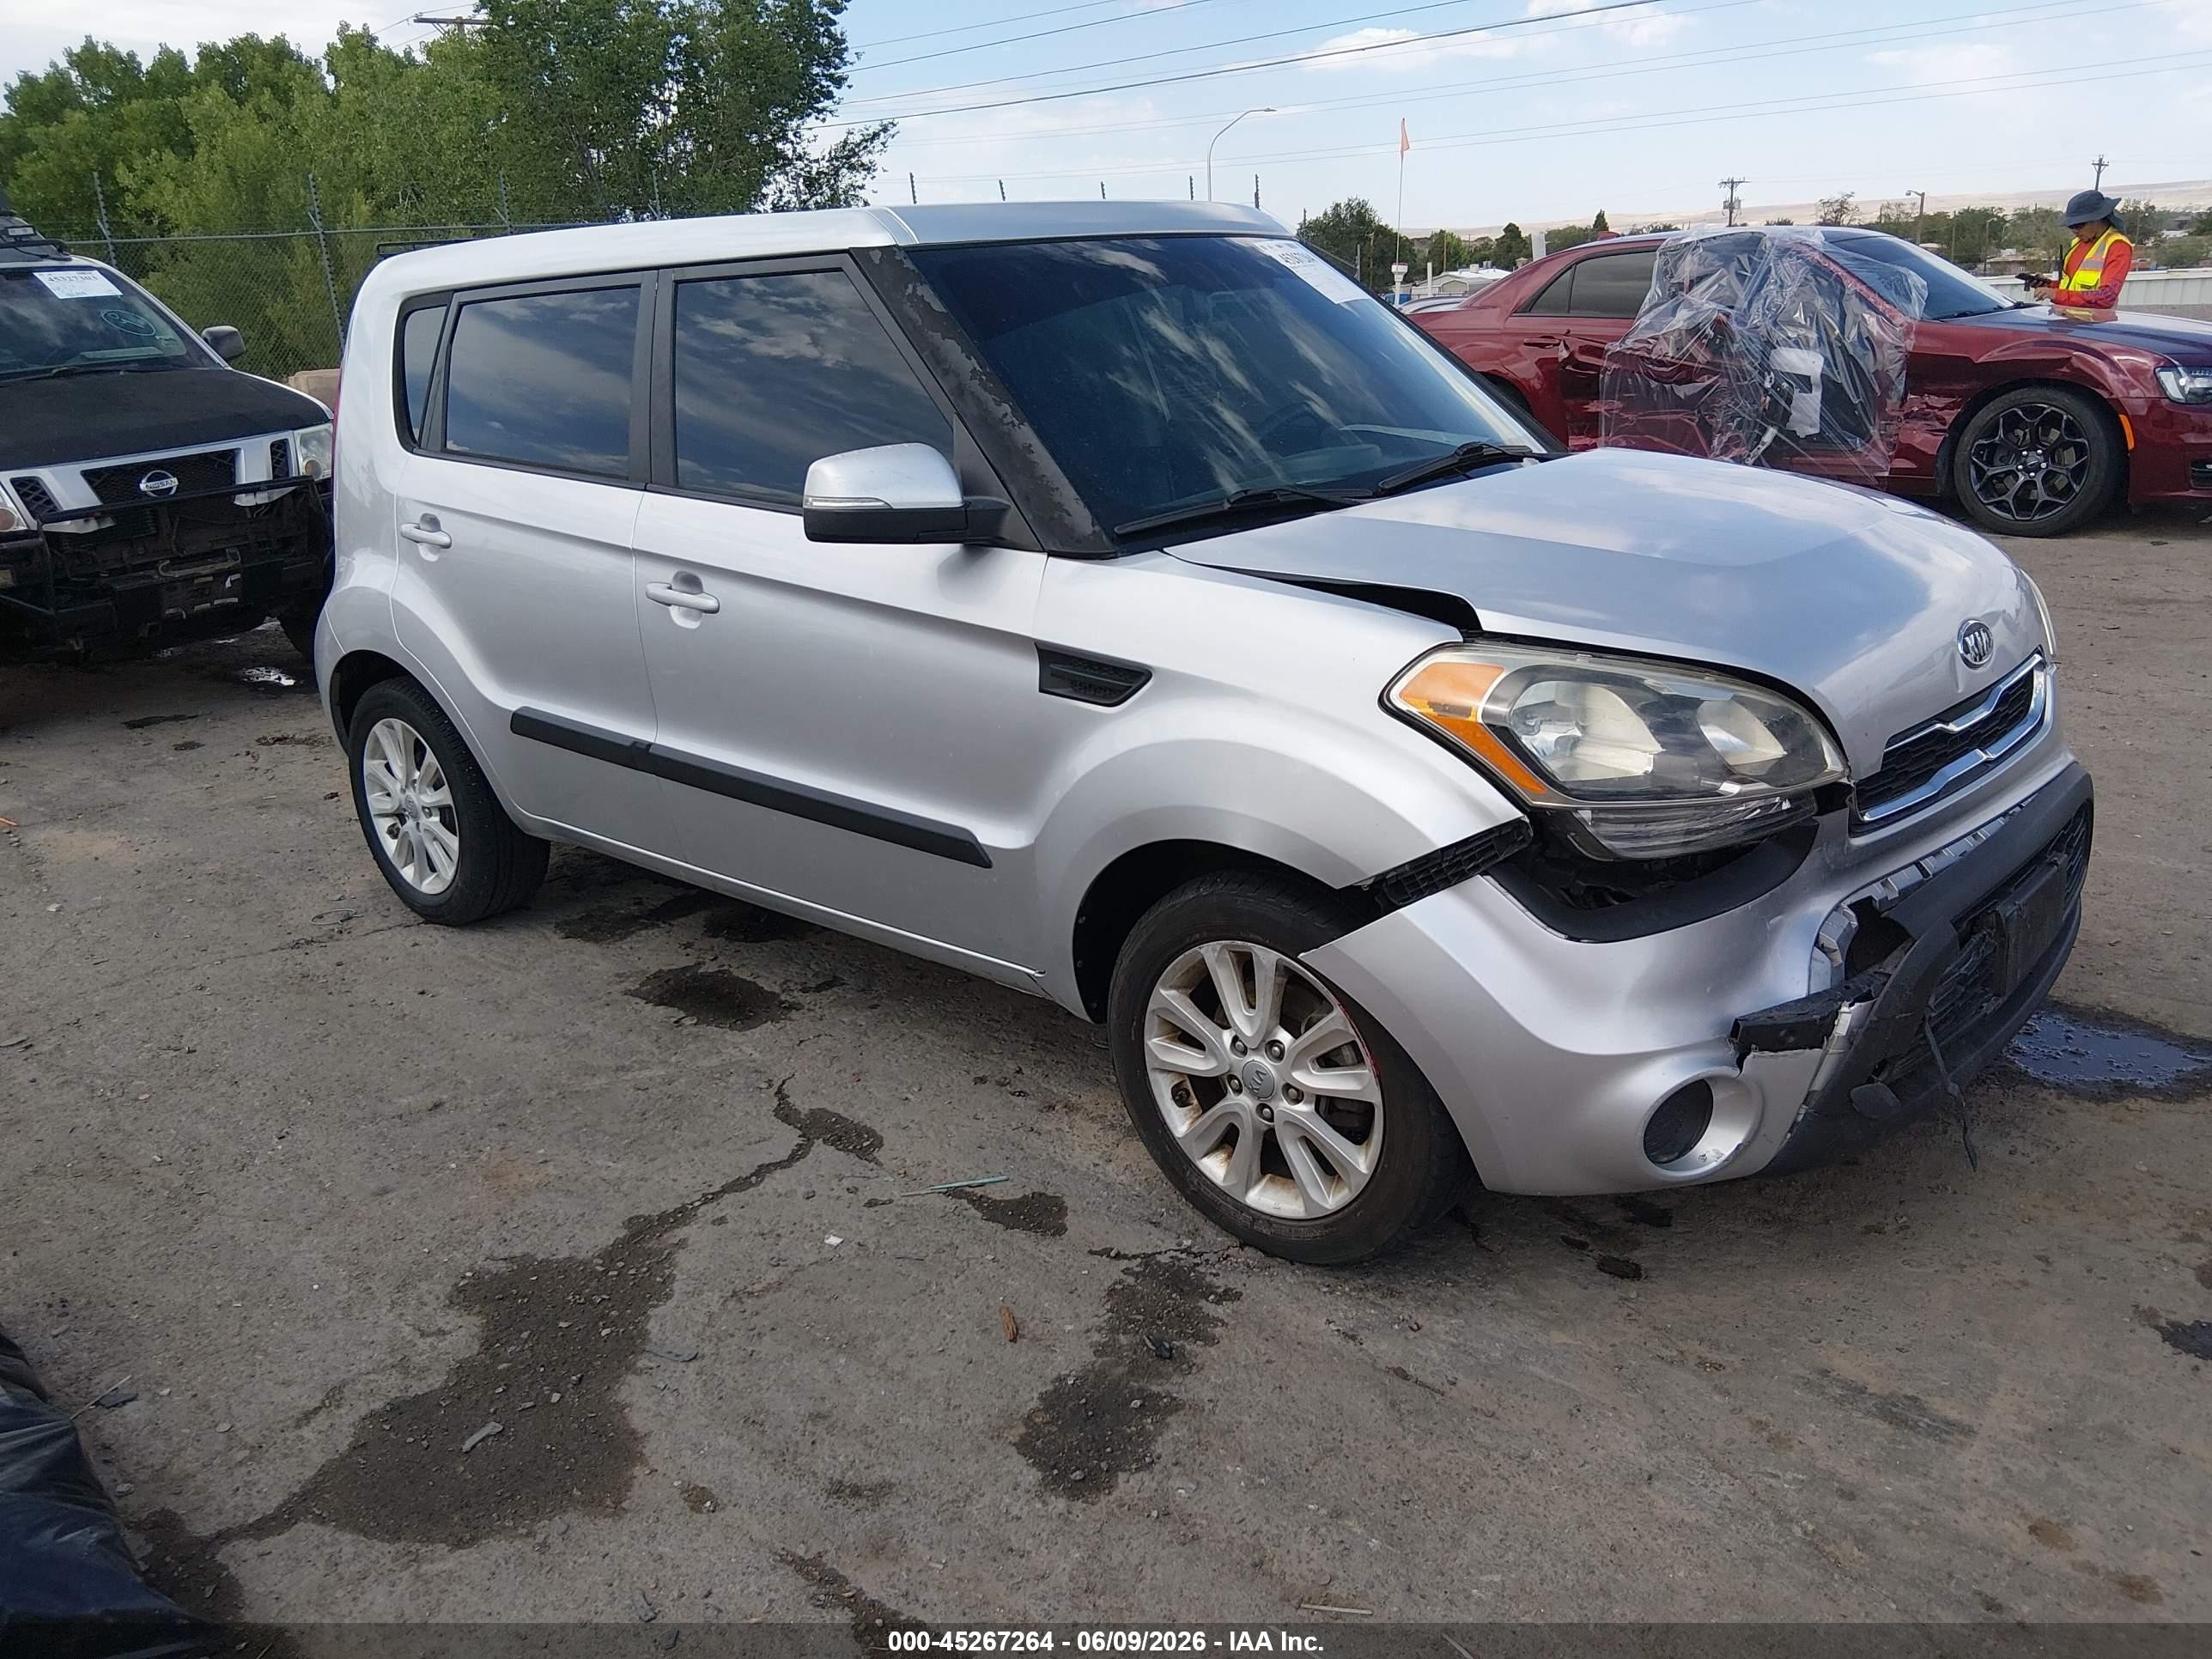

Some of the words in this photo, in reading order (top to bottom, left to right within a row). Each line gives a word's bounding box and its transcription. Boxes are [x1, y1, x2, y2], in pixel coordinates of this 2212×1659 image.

[144, 480, 176, 490] NISSAN
[1963, 627, 1990, 660] KIA
[1249, 1068, 1267, 1093] KIA
